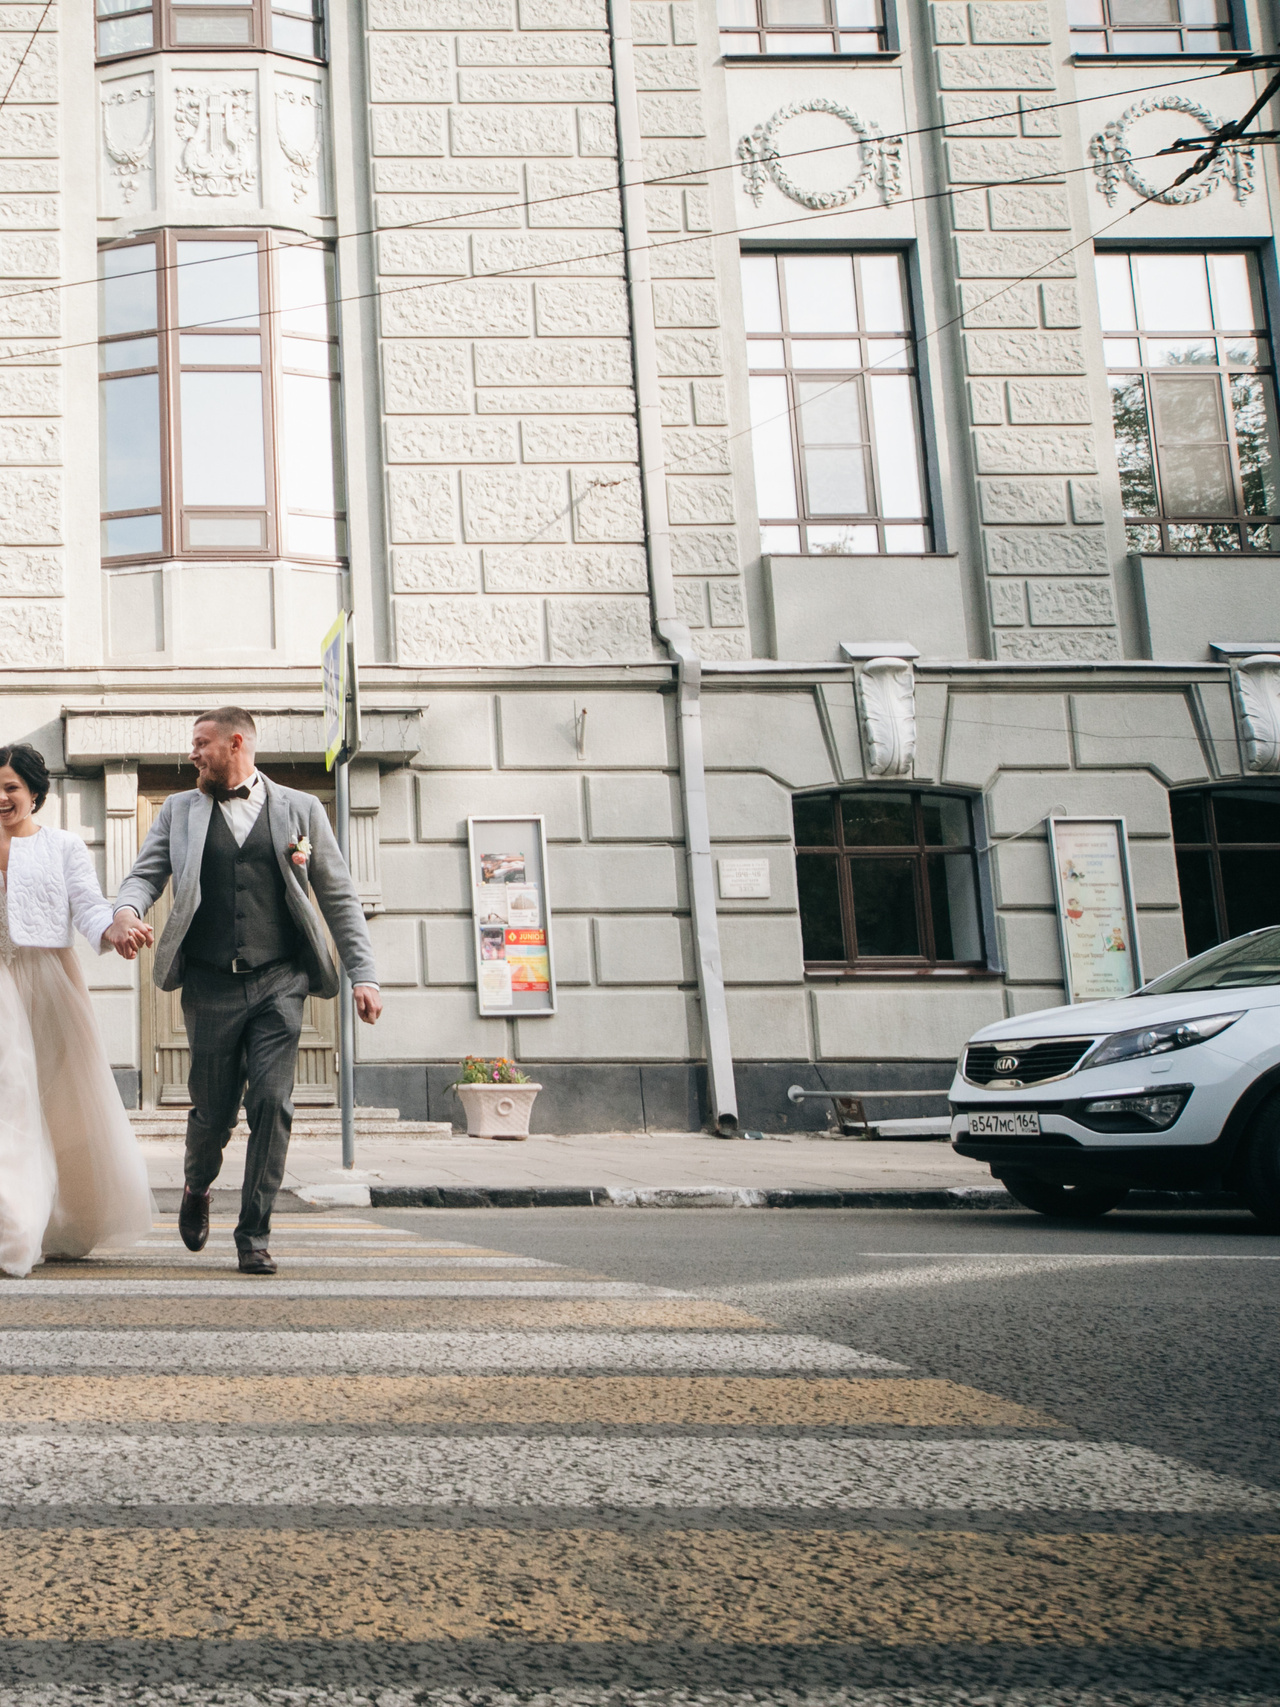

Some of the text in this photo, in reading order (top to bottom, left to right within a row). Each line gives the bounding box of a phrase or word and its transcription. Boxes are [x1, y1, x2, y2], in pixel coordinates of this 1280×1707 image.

[996, 1059, 1013, 1070] KIA
[971, 1114, 1037, 1132] В547МС 164
